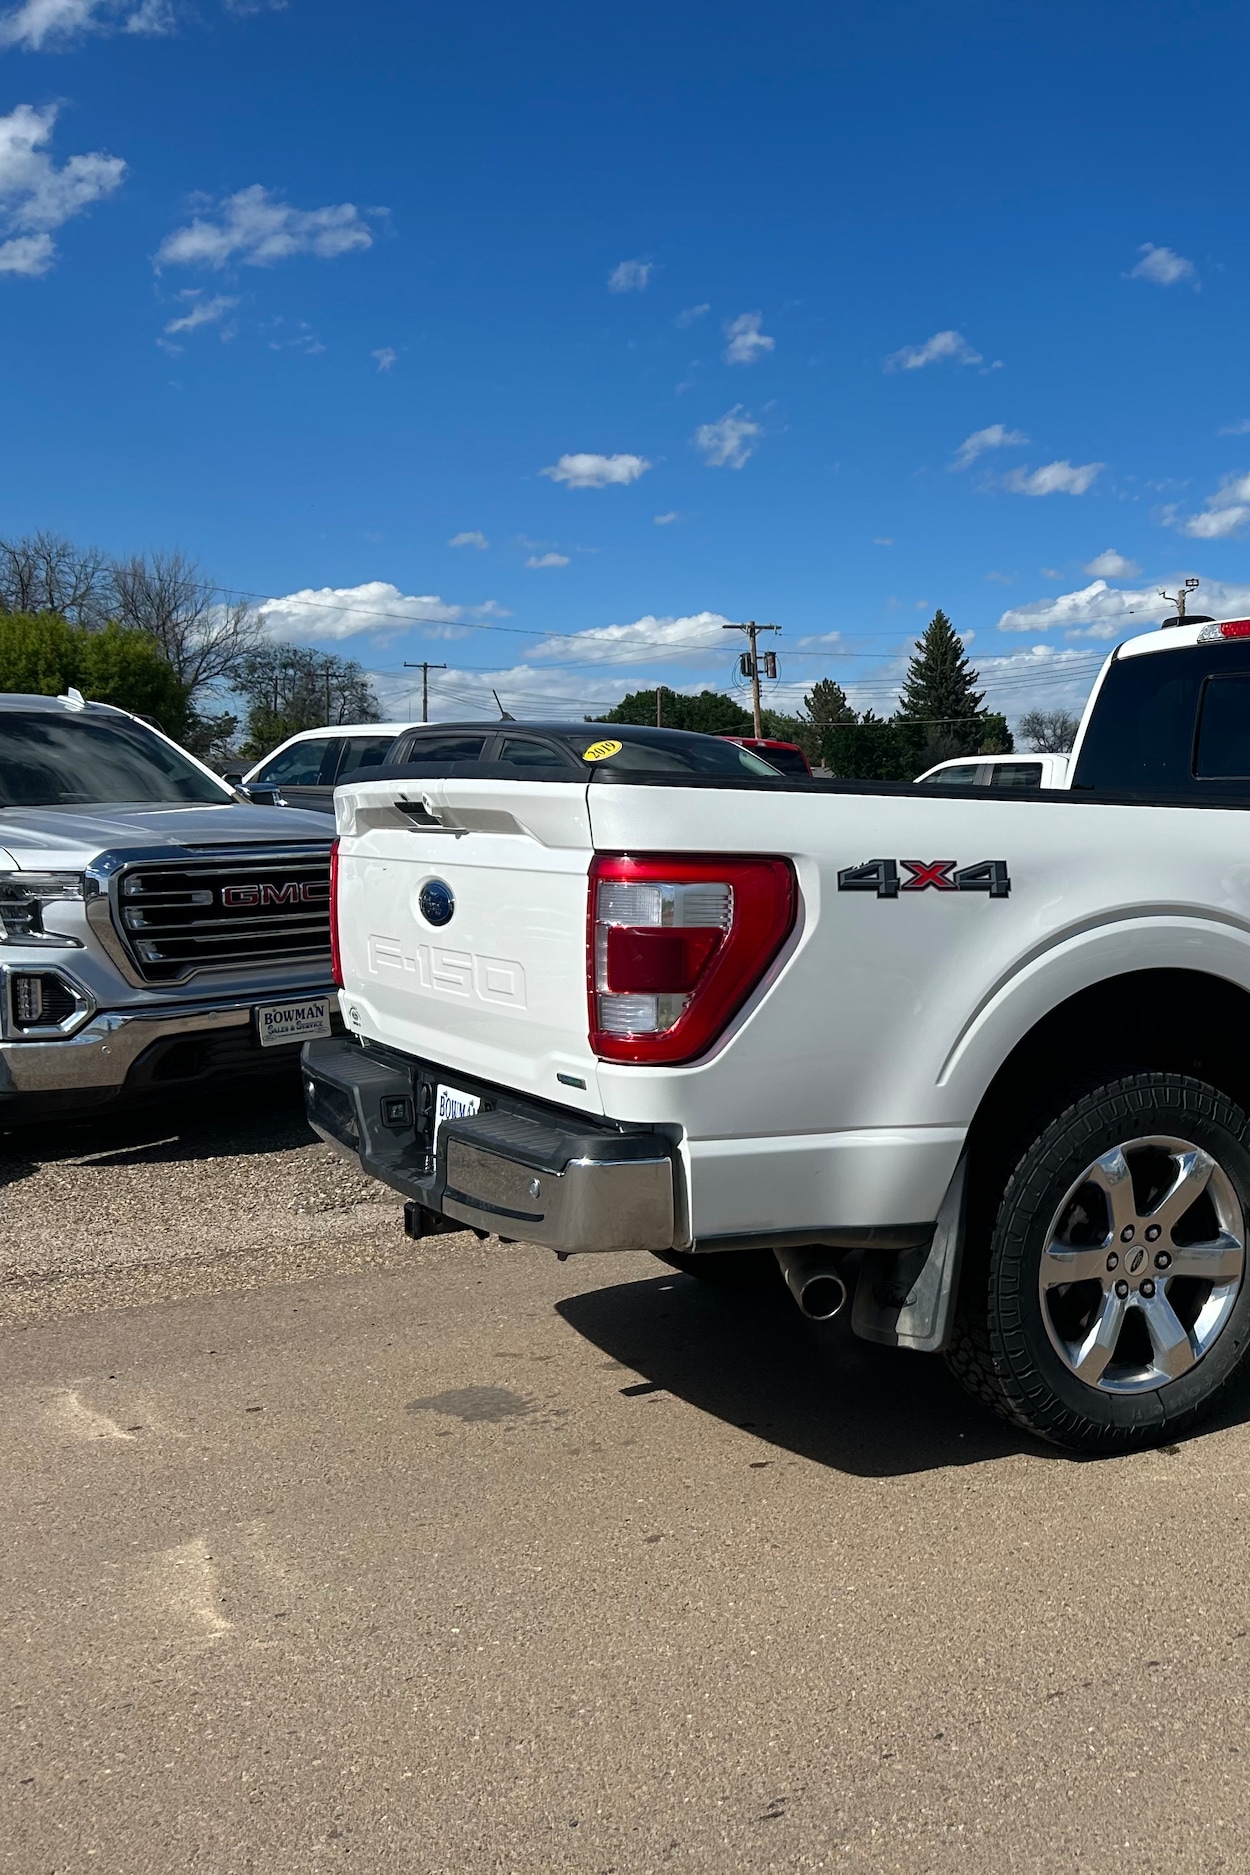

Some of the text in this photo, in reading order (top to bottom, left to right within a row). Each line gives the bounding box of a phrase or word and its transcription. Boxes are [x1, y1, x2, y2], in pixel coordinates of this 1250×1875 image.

[222, 880, 331, 908] GMC
[368, 933, 528, 1011] F-150
[264, 1005, 324, 1025] BOWMAN
